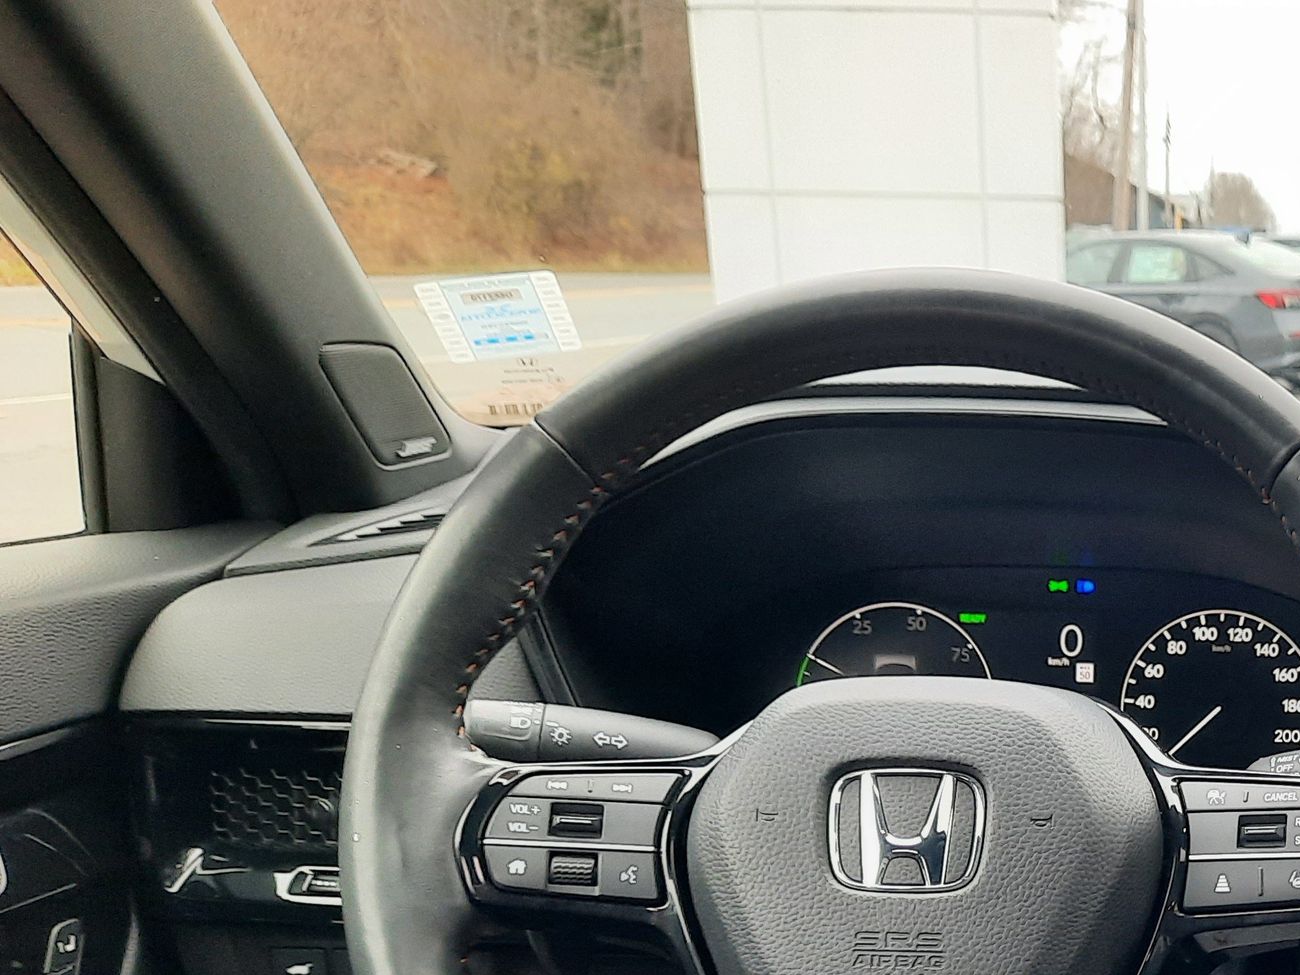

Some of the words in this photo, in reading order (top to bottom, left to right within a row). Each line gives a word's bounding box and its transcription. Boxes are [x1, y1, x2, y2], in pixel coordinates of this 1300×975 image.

[852, 621, 873, 635] 25
[906, 617, 927, 631] 50
[1059, 624, 1084, 657] 0
[1192, 628, 1218, 642] 100
[1227, 628, 1252, 642] 120
[951, 647, 970, 662] 75
[1167, 641, 1187, 655] 80
[1254, 643, 1280, 657] 140
[1144, 664, 1164, 678] 60
[1273, 668, 1298, 682] 160
[1135, 695, 1155, 709] 40
[1274, 729, 1300, 743] 200
[1277, 755, 1299, 763] MIST
[1276, 763, 1294, 773] OFF
[1264, 792, 1298, 802] CANCEL
[853, 931, 944, 949] SRS
[852, 953, 944, 969] AIRBAG
